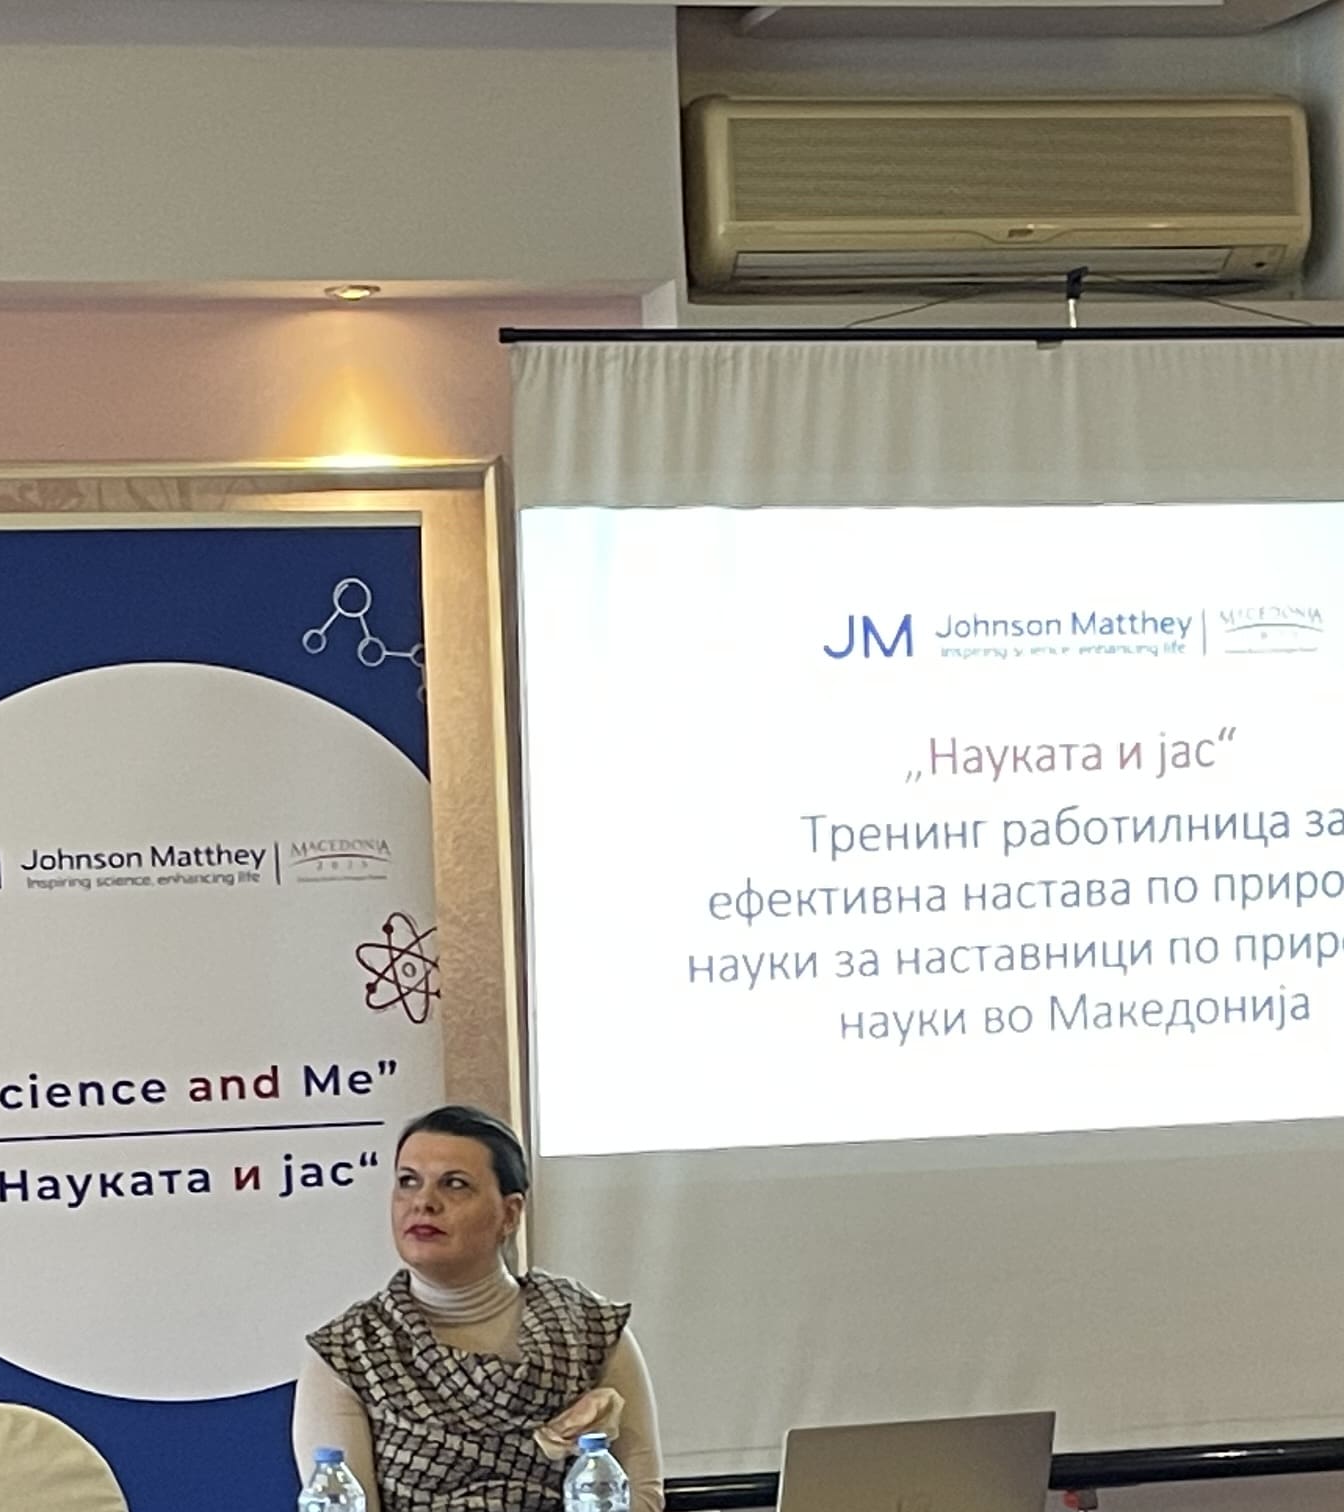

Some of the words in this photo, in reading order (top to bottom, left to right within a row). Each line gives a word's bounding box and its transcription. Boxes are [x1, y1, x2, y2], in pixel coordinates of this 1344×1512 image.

[823, 613, 913, 660] JM
[935, 612, 1062, 639] Johnson
[1071, 610, 1193, 640] Matthey
[1119, 741, 1143, 770] и
[290, 839, 392, 857] MACEDONIA
[800, 814, 987, 862] Тренинг
[1003, 804, 1290, 857] работилница
[20, 848, 144, 871] Johnson
[150, 843, 267, 870] Matthey
[26, 876, 92, 891] Inspiring
[157, 871, 236, 887] enhancing
[238, 870, 261, 884] life
[708, 876, 946, 927] ефективна
[964, 878, 1131, 912] настава
[1147, 875, 1199, 905] по
[688, 951, 818, 991] науки
[835, 948, 880, 979] за
[896, 939, 1153, 978] наставници
[1169, 936, 1219, 966] по
[840, 1008, 967, 1047] науки
[984, 1005, 1033, 1034] во
[1049, 984, 1311, 1036] Македонија
[189, 1064, 280, 1103] and
[234, 1165, 262, 1191] и
